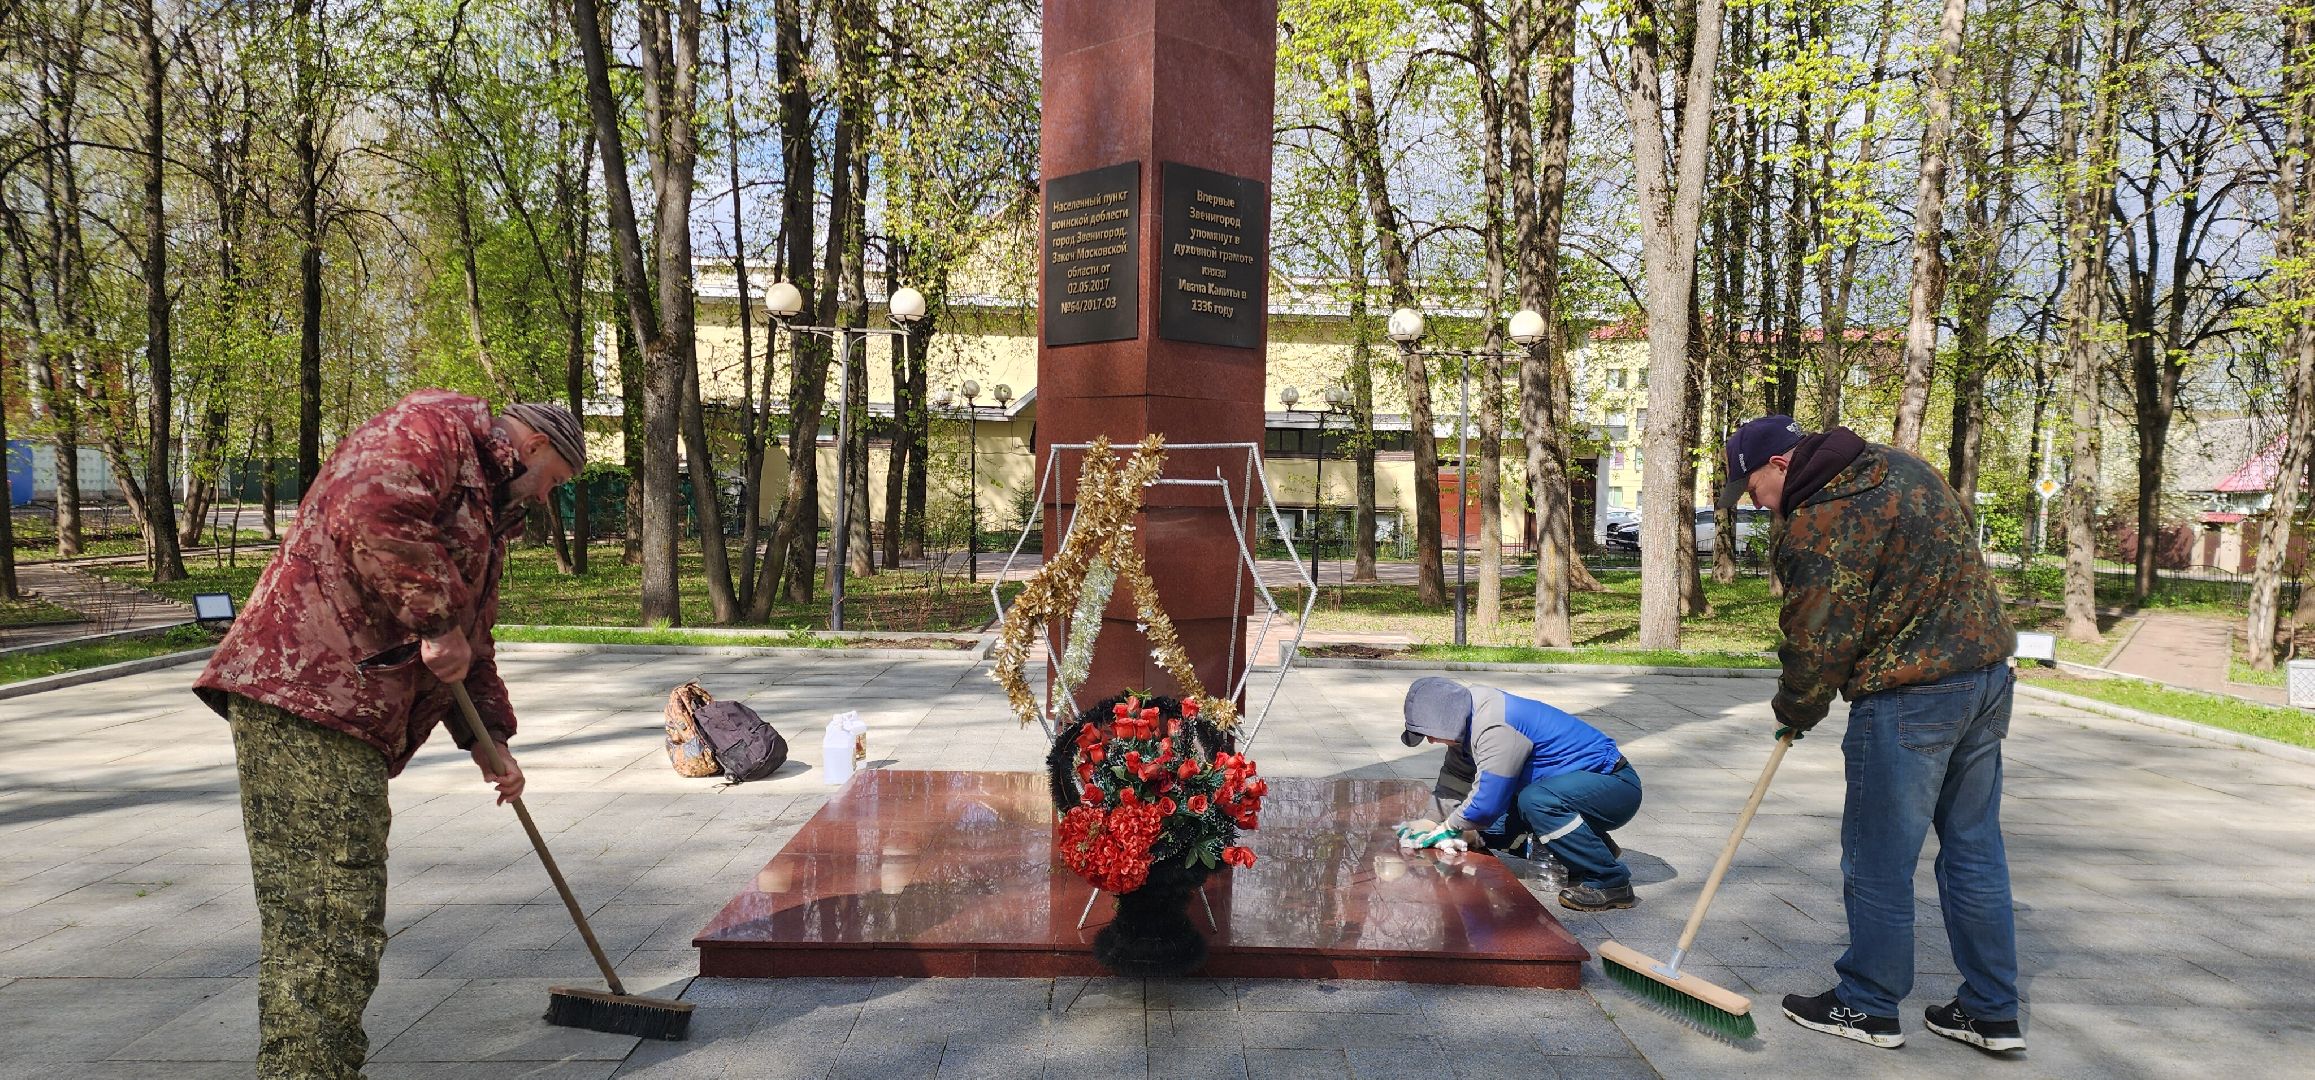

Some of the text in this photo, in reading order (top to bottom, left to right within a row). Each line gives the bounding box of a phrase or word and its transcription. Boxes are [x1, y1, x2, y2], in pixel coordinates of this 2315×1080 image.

[1053, 190, 1129, 214] Населенный пункт
[1196, 189, 1236, 208] Впервые
[1051, 208, 1129, 231] воинской доблести
[1189, 206, 1241, 229] Звенигород
[1052, 235, 1076, 249] город
[1189, 227, 1241, 246] упомянут в
[1052, 241, 1128, 264] Закон Московской
[1173, 243, 1254, 264] духовной грамоте
[1067, 263, 1111, 279] области от
[1201, 265, 1227, 279] князя
[1067, 277, 1110, 295] 02.05.2017
[1178, 278, 1248, 300] Ивана Калиты в
[1191, 299, 1234, 319] 1336 году
